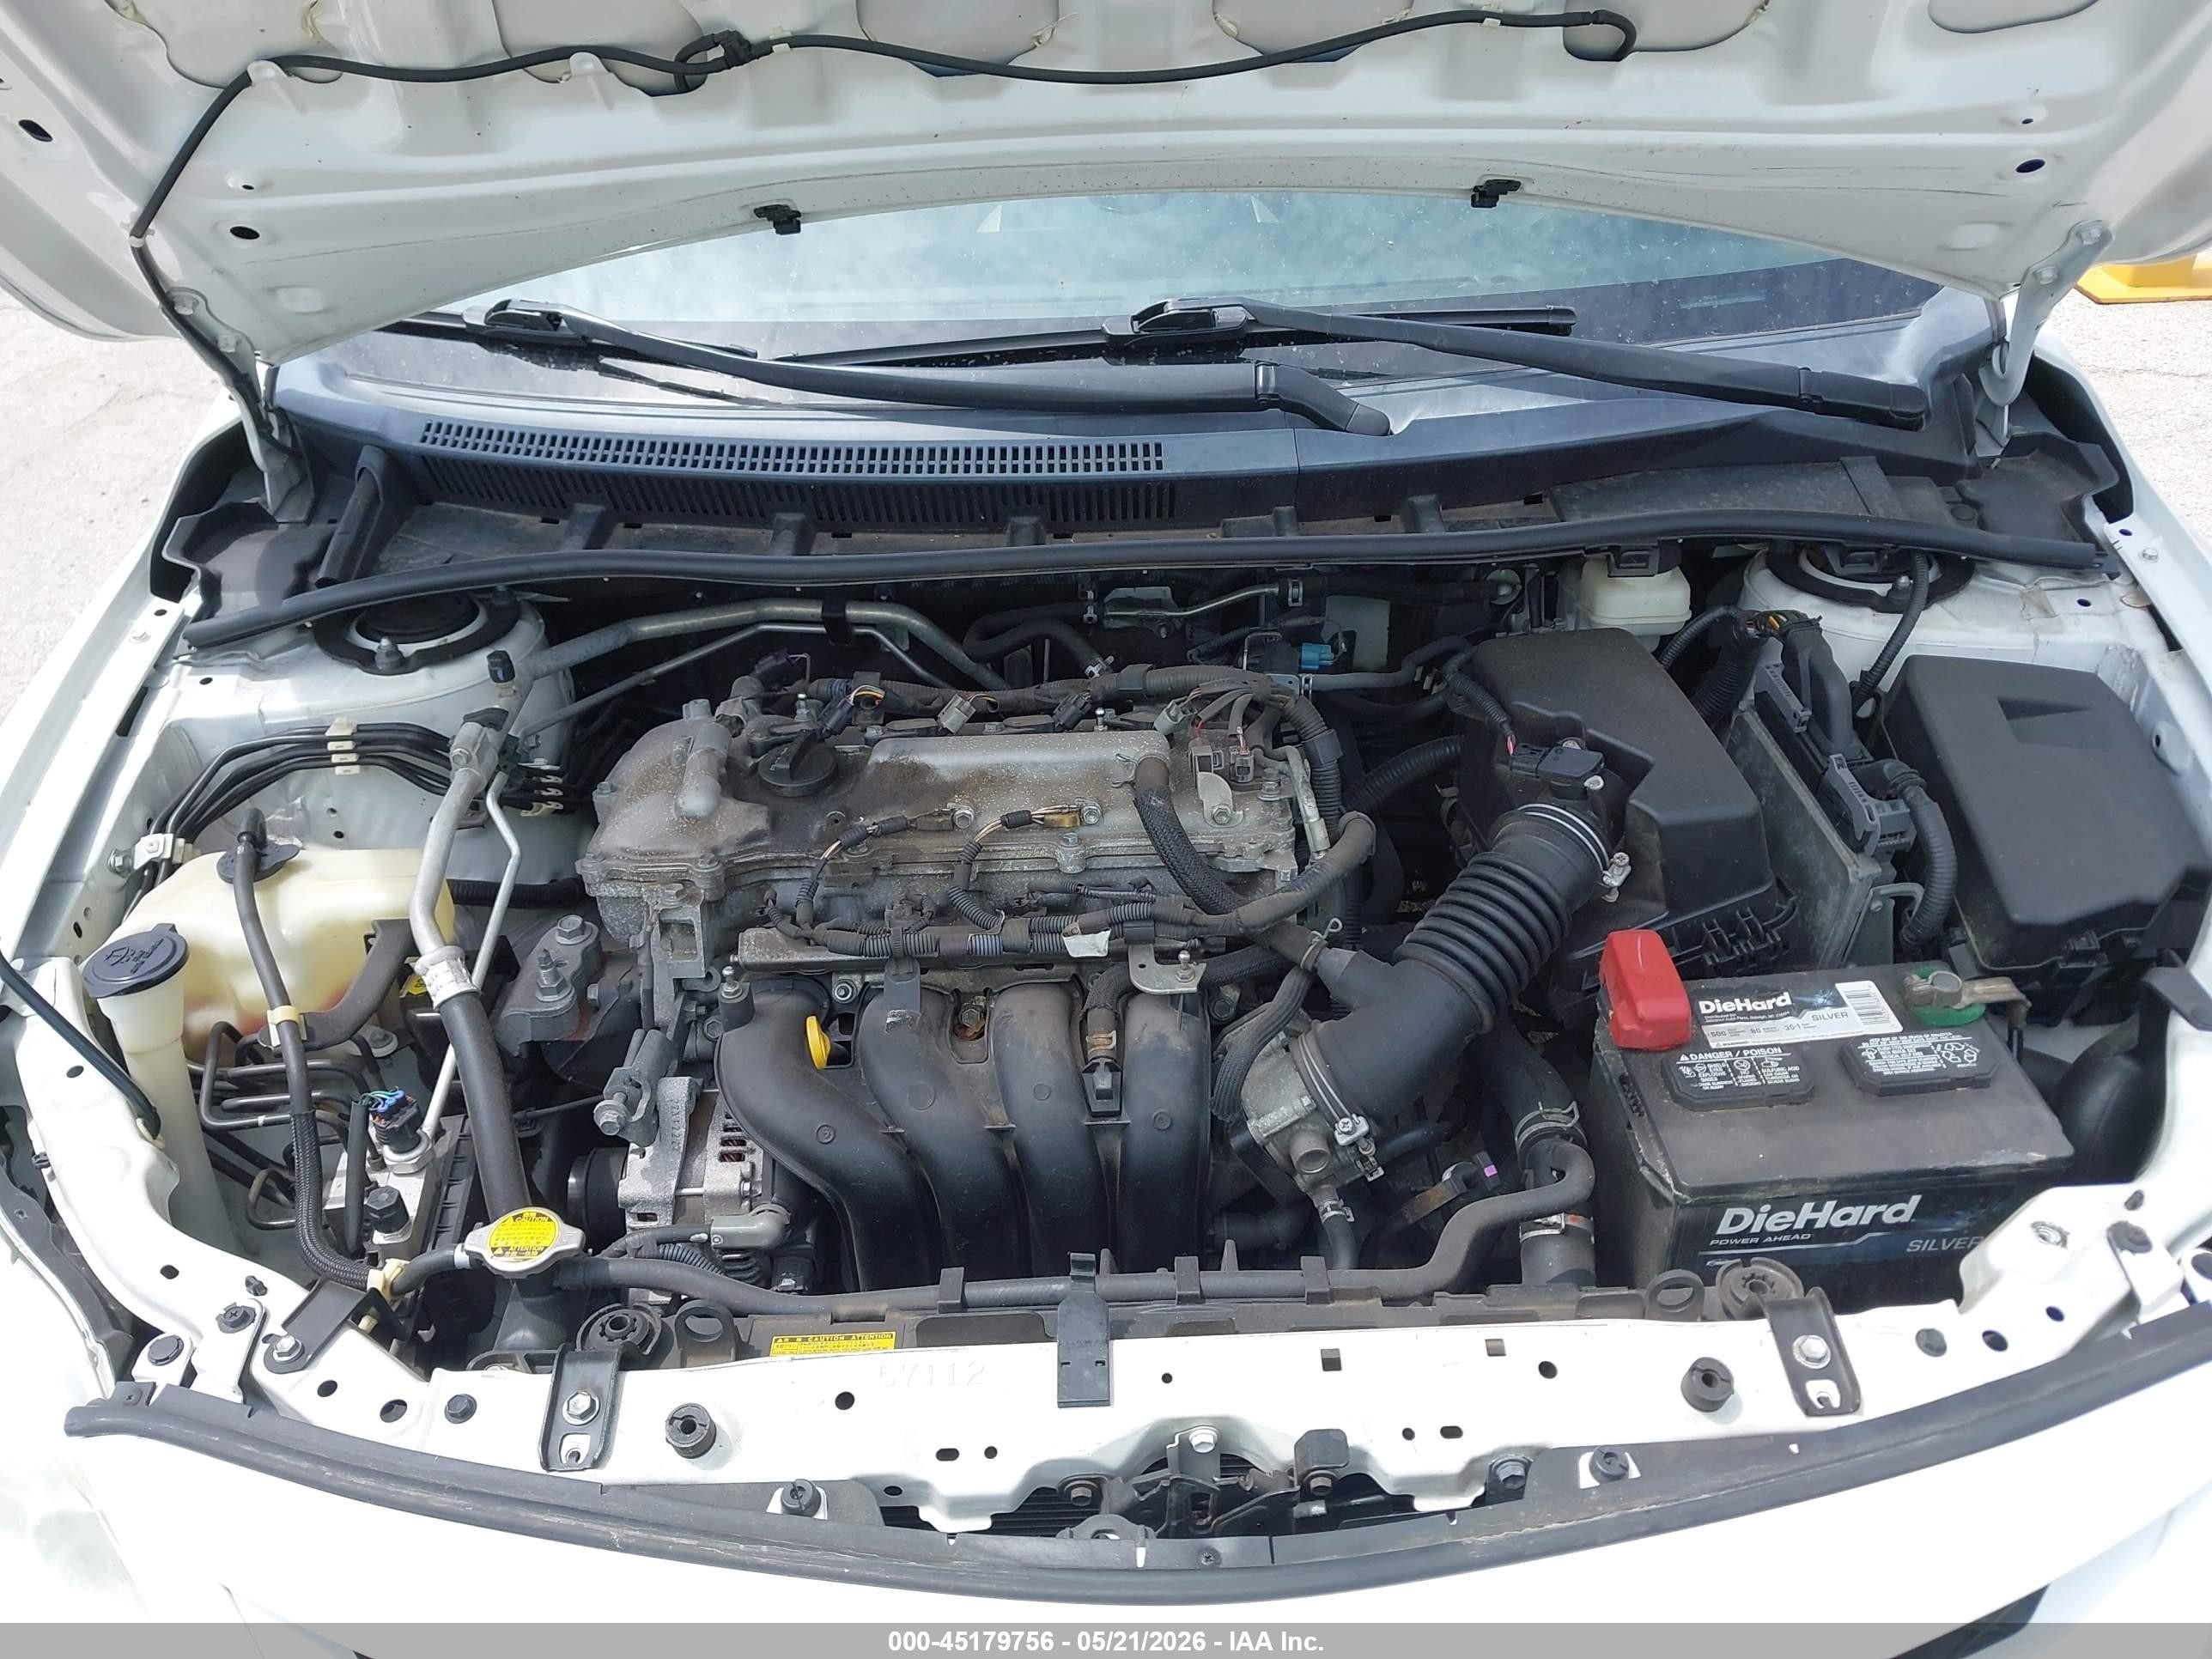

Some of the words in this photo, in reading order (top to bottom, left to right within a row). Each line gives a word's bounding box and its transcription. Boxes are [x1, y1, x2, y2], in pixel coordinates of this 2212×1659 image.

[1698, 992, 1792, 1014] DieHard
[1811, 1012, 1849, 1022] SILVER
[1689, 1049, 1733, 1060] DANGER
[1743, 1047, 1783, 1056] POISON
[1716, 1194, 1923, 1236] DieHard
[1763, 1233, 1812, 1243] AHEAD
